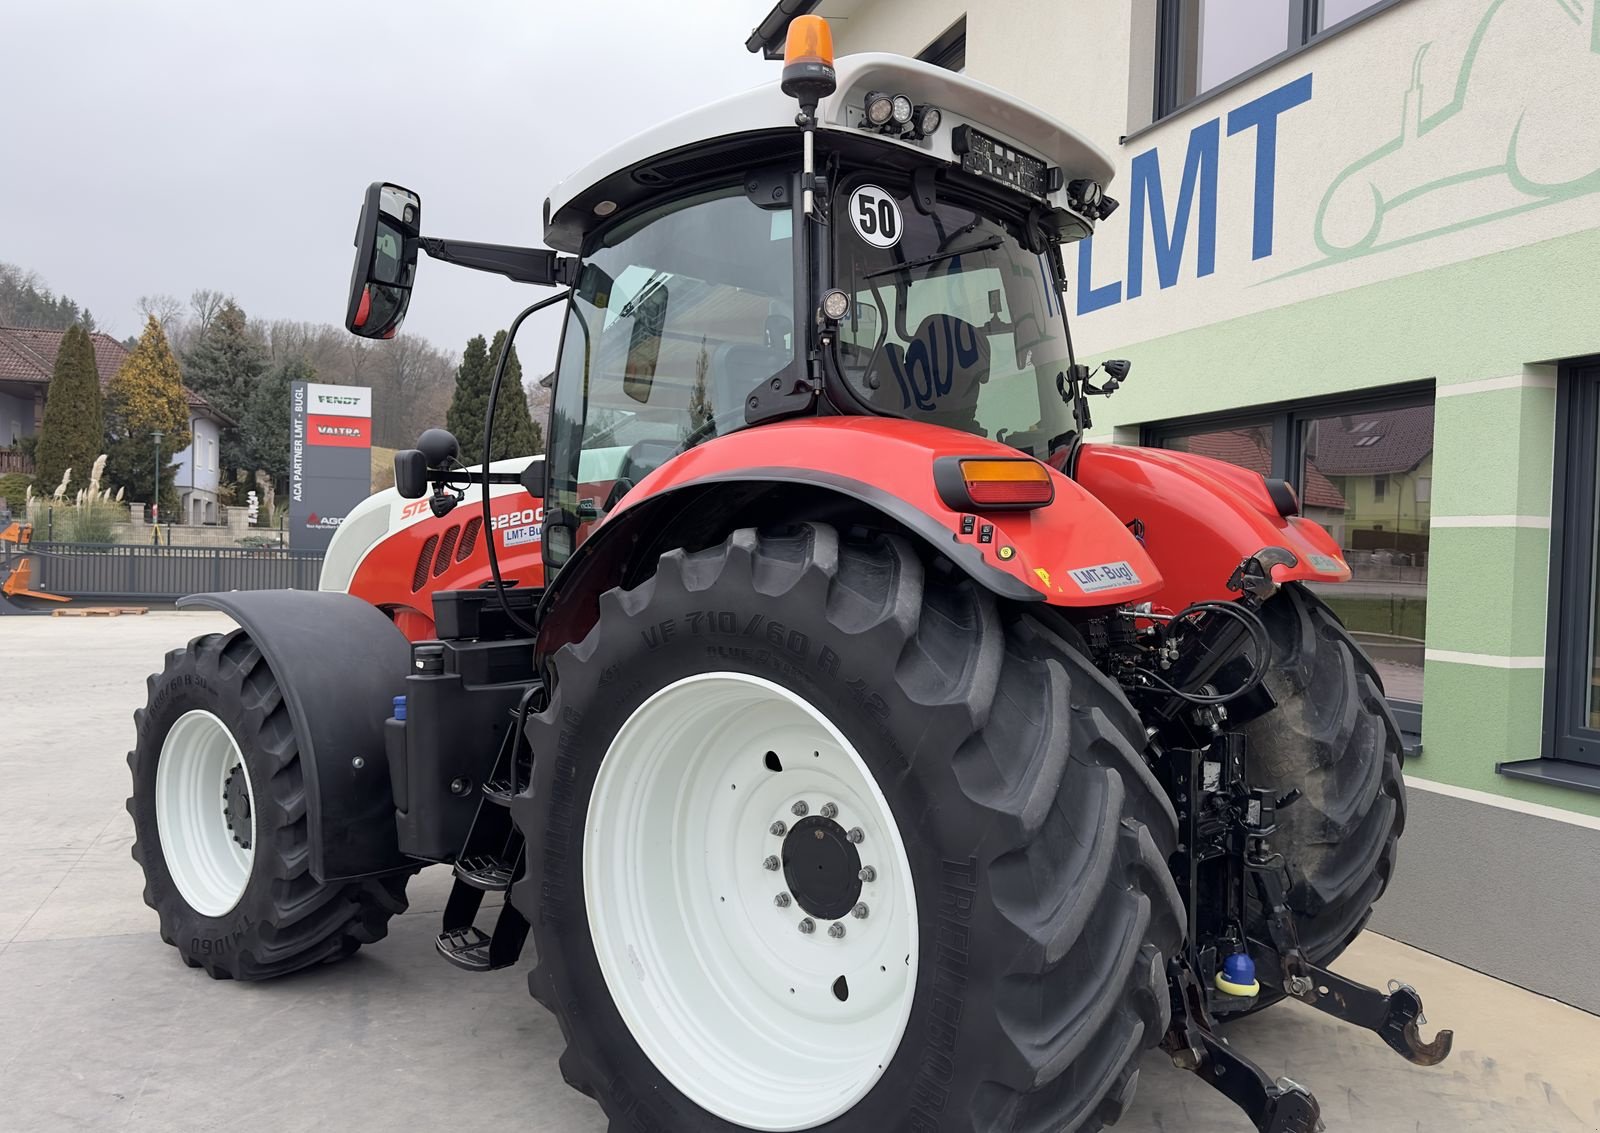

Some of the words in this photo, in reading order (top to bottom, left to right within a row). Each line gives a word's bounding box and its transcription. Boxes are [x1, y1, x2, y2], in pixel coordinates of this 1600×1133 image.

[1076, 72, 1313, 316] LMT
[858, 193, 896, 239] 50
[295, 387, 304, 412] BUGL
[317, 395, 361, 406] FENDT
[294, 419, 304, 438] LMT
[317, 426, 361, 437] VALTRA
[293, 439, 304, 482] PARTNER
[293, 483, 303, 502] ACA
[320, 516, 345, 525] AGC
[685, 610, 809, 659] 710/60
